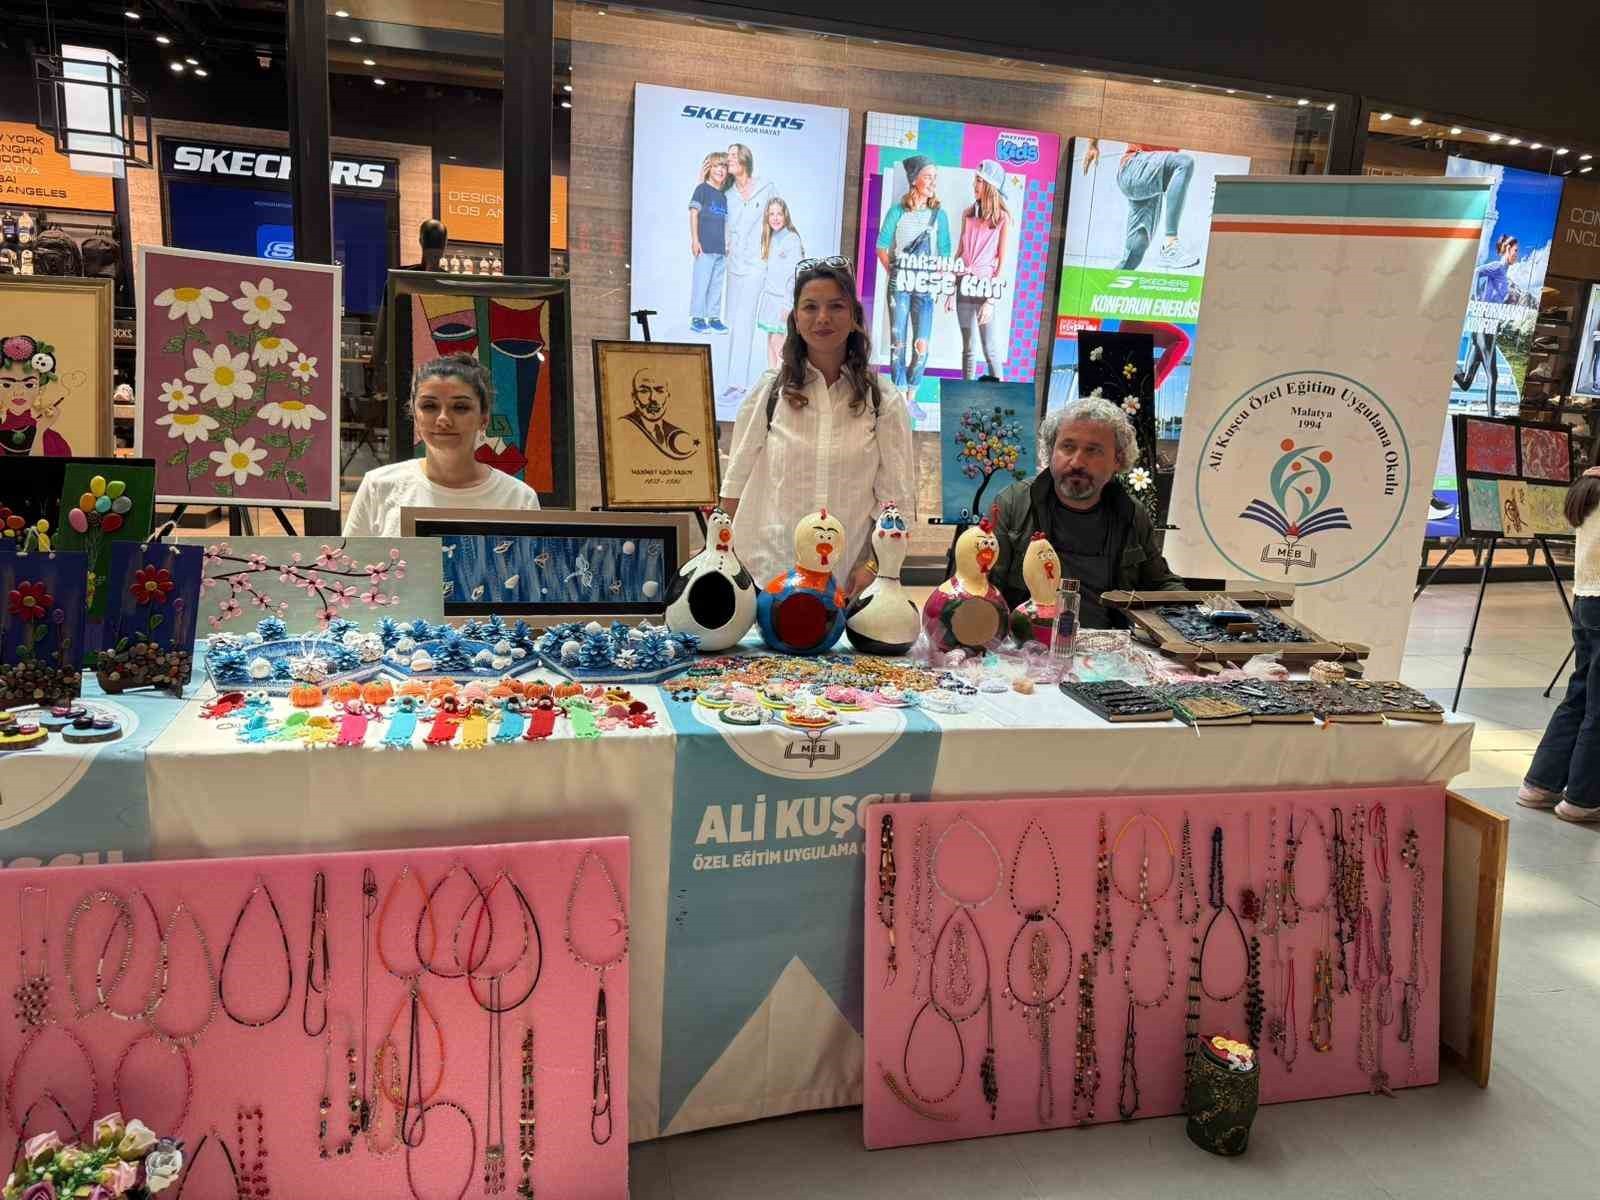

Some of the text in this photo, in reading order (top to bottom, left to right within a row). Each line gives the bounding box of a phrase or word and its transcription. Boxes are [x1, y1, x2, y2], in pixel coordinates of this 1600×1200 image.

[681, 105, 806, 131] SKECHERS
[6, 134, 45, 146] YORK
[0, 144, 43, 156] NGHAI
[173, 146, 385, 188] SKECRS
[7, 185, 67, 199] ANGELES
[448, 205, 480, 217] LOS
[1290, 405, 1333, 420] Malatya
[1298, 419, 1322, 431] 1994
[1209, 450, 1224, 472] Ali
[1248, 385, 1283, 411] Özel
[1286, 380, 1337, 397] Eğitim
[1340, 388, 1393, 449] Uygulama
[1383, 450, 1400, 497] Okulu
[1277, 548, 1302, 559] MEB
[801, 744, 826, 754] MEB
[694, 794, 768, 845] ALİ
[692, 852, 730, 872] ÖZEL
[732, 848, 782, 869] EĞİTİM
[783, 841, 859, 864] UYGULAMA
